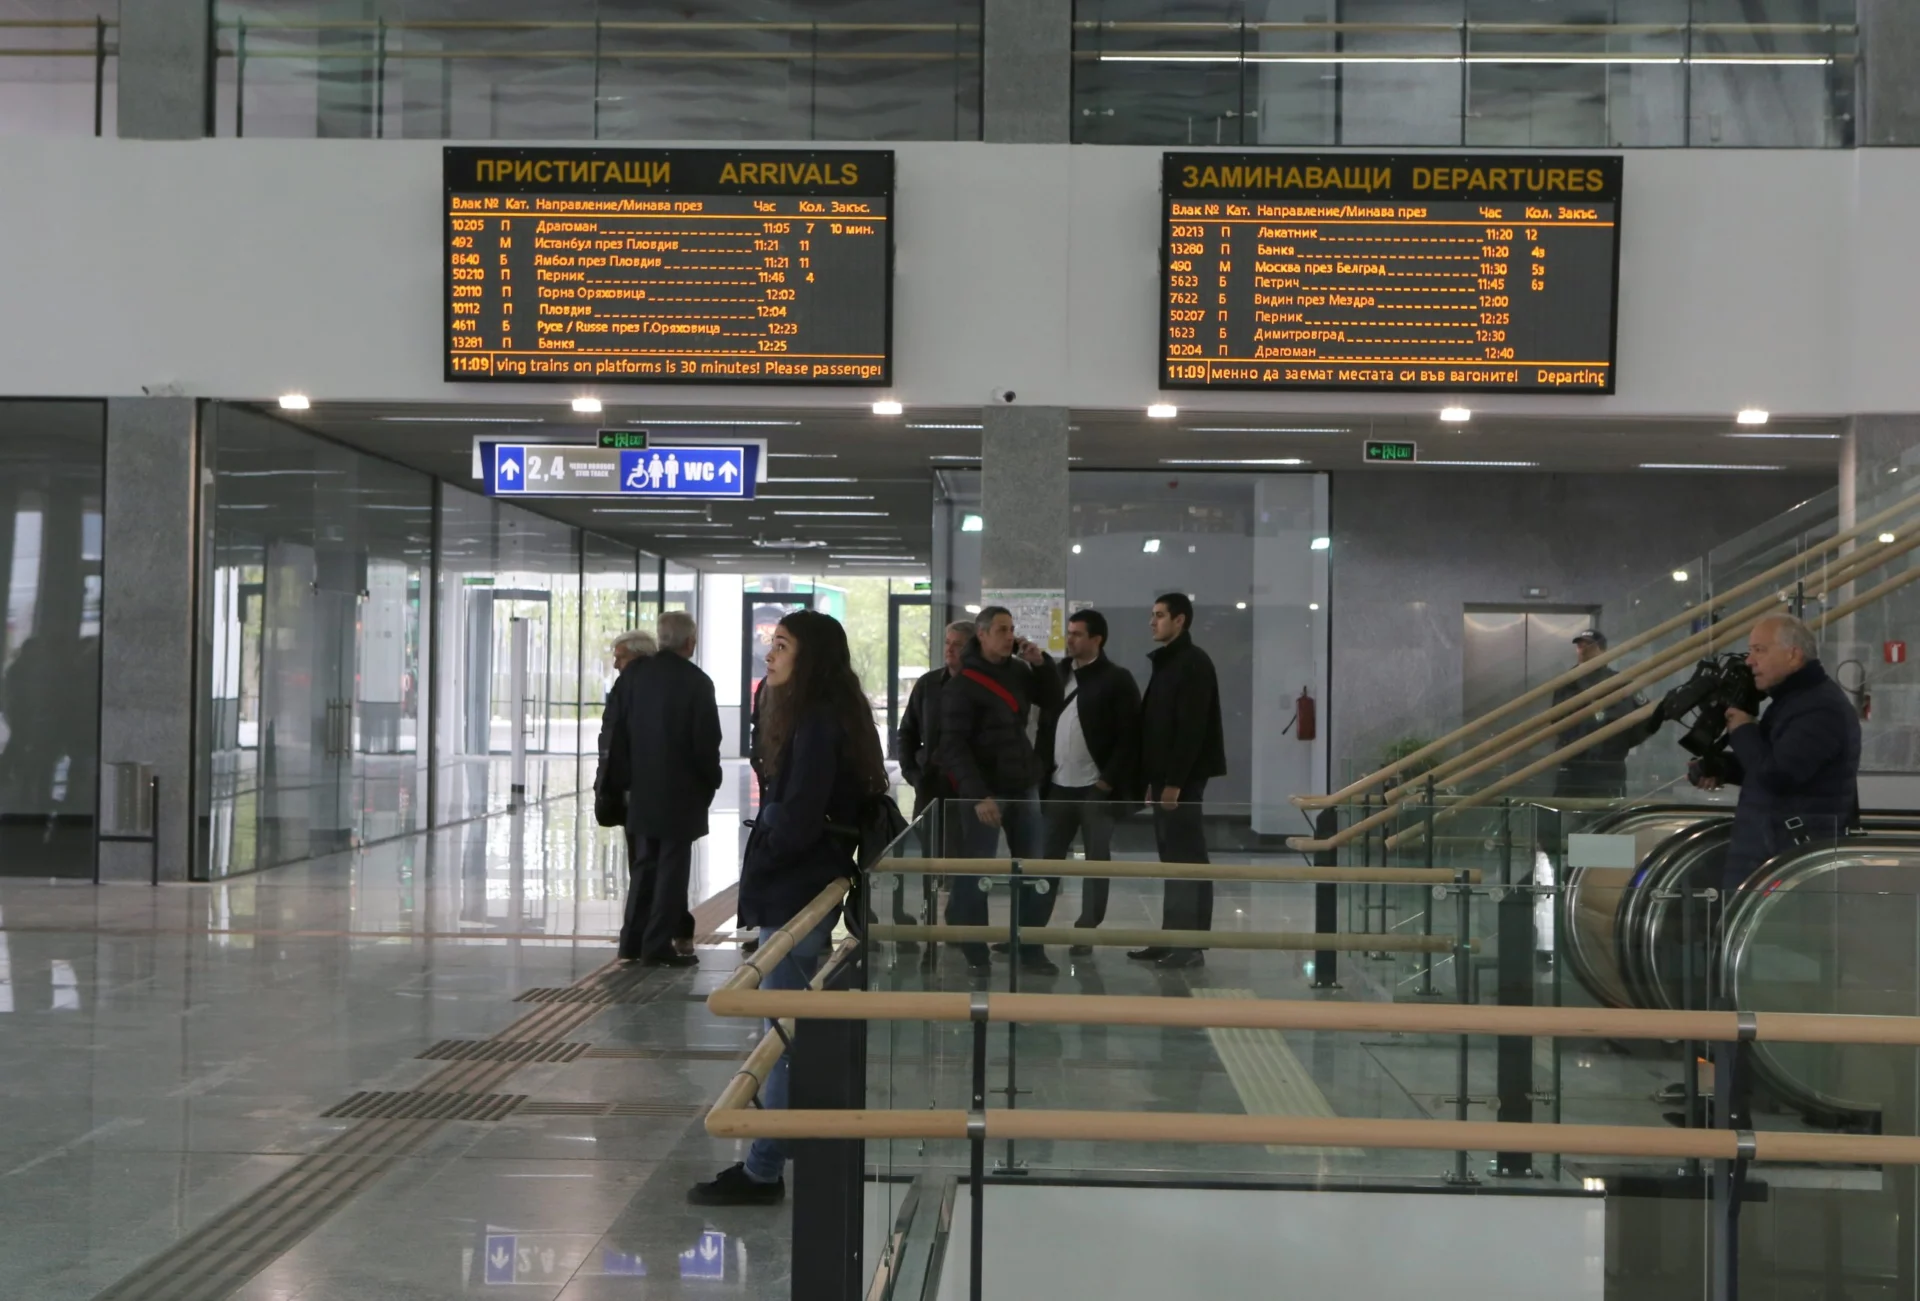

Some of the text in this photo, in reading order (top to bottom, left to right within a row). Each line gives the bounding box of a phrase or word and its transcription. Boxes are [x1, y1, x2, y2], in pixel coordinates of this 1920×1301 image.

[477, 160, 670, 186] ПРИСТИГАЩИ
[719, 162, 858, 185] ARRIVALS
[1182, 166, 1390, 192] ЗАМИНАВАЩИ
[1413, 168, 1603, 191] DEPARTURES
[452, 197, 870, 213] Влак № Кат. Направление/Минава през Час Кол. Закъс.
[1172, 205, 1597, 219] Влак № Кат. Направление/Минава през Час Кол. Закъс.
[452, 220, 874, 234] 10205 П Драгоман 11:05 7 10 мин.
[1172, 226, 1537, 240] 20213 П Лакатник 11:20 12
[452, 237, 810, 251] 492 М Истанбул през Пловдив 11:21 11
[1171, 244, 1203, 254] 13280
[1221, 244, 1230, 254] П
[1258, 245, 1294, 255] Банкя
[1482, 246, 1509, 258] 11:20
[452, 254, 810, 268] 8640 Б Ямбол през Пловдив 11:21 11
[1170, 261, 1191, 271] 490
[1220, 262, 1230, 272] М
[1256, 262, 1300, 272] Москва
[1305, 264, 1332, 274] през
[1337, 262, 1385, 275] Белград
[1481, 264, 1507, 274] 11:30
[452, 268, 814, 283] 50210 П Перник 11:46 4
[1171, 276, 1198, 286] 5623
[1219, 276, 1227, 287] Б
[1255, 277, 1299, 289] Петрич
[1478, 279, 1504, 290] 11:45
[452, 286, 795, 300] 20110 П Горна Оряховица 12:02
[1170, 293, 1508, 307] 7622 Б Видин през Мездра 12:00
[452, 303, 787, 317] 10112 П Пловдив 12:04
[1170, 310, 1510, 324] 50207 П Перник 12:25
[452, 320, 476, 331] 4611
[502, 320, 510, 331] Б
[537, 321, 563, 333] Русе
[576, 322, 608, 332] Russe
[612, 323, 639, 334] през
[643, 322, 720, 335] Г.Оряховица
[768, 324, 798, 335] 12:23
[1169, 327, 1505, 342] 1623 Б Димитровград 12:30
[452, 337, 788, 352] 13281 П Банкя 12:25
[1169, 344, 1514, 359] 10204 П Драгоман 12:40
[452, 358, 489, 370] 11:09
[530, 359, 569, 371] trains
[574, 361, 591, 372] on
[596, 360, 661, 375] platforms
[666, 361, 676, 373] is
[681, 361, 696, 373] 30
[701, 361, 760, 374] minutes!
[765, 363, 808, 375] Please
[1168, 366, 1205, 378] 11:09
[1211, 368, 1258, 379] менно
[1263, 369, 1278, 380] да
[1285, 369, 1333, 379] заемат
[1339, 369, 1394, 380] местата
[1400, 371, 1415, 381] си
[1421, 372, 1445, 381] във
[1451, 370, 1518, 382] вагоните!
[528, 456, 565, 480] 2,4
[684, 461, 714, 481] WC
